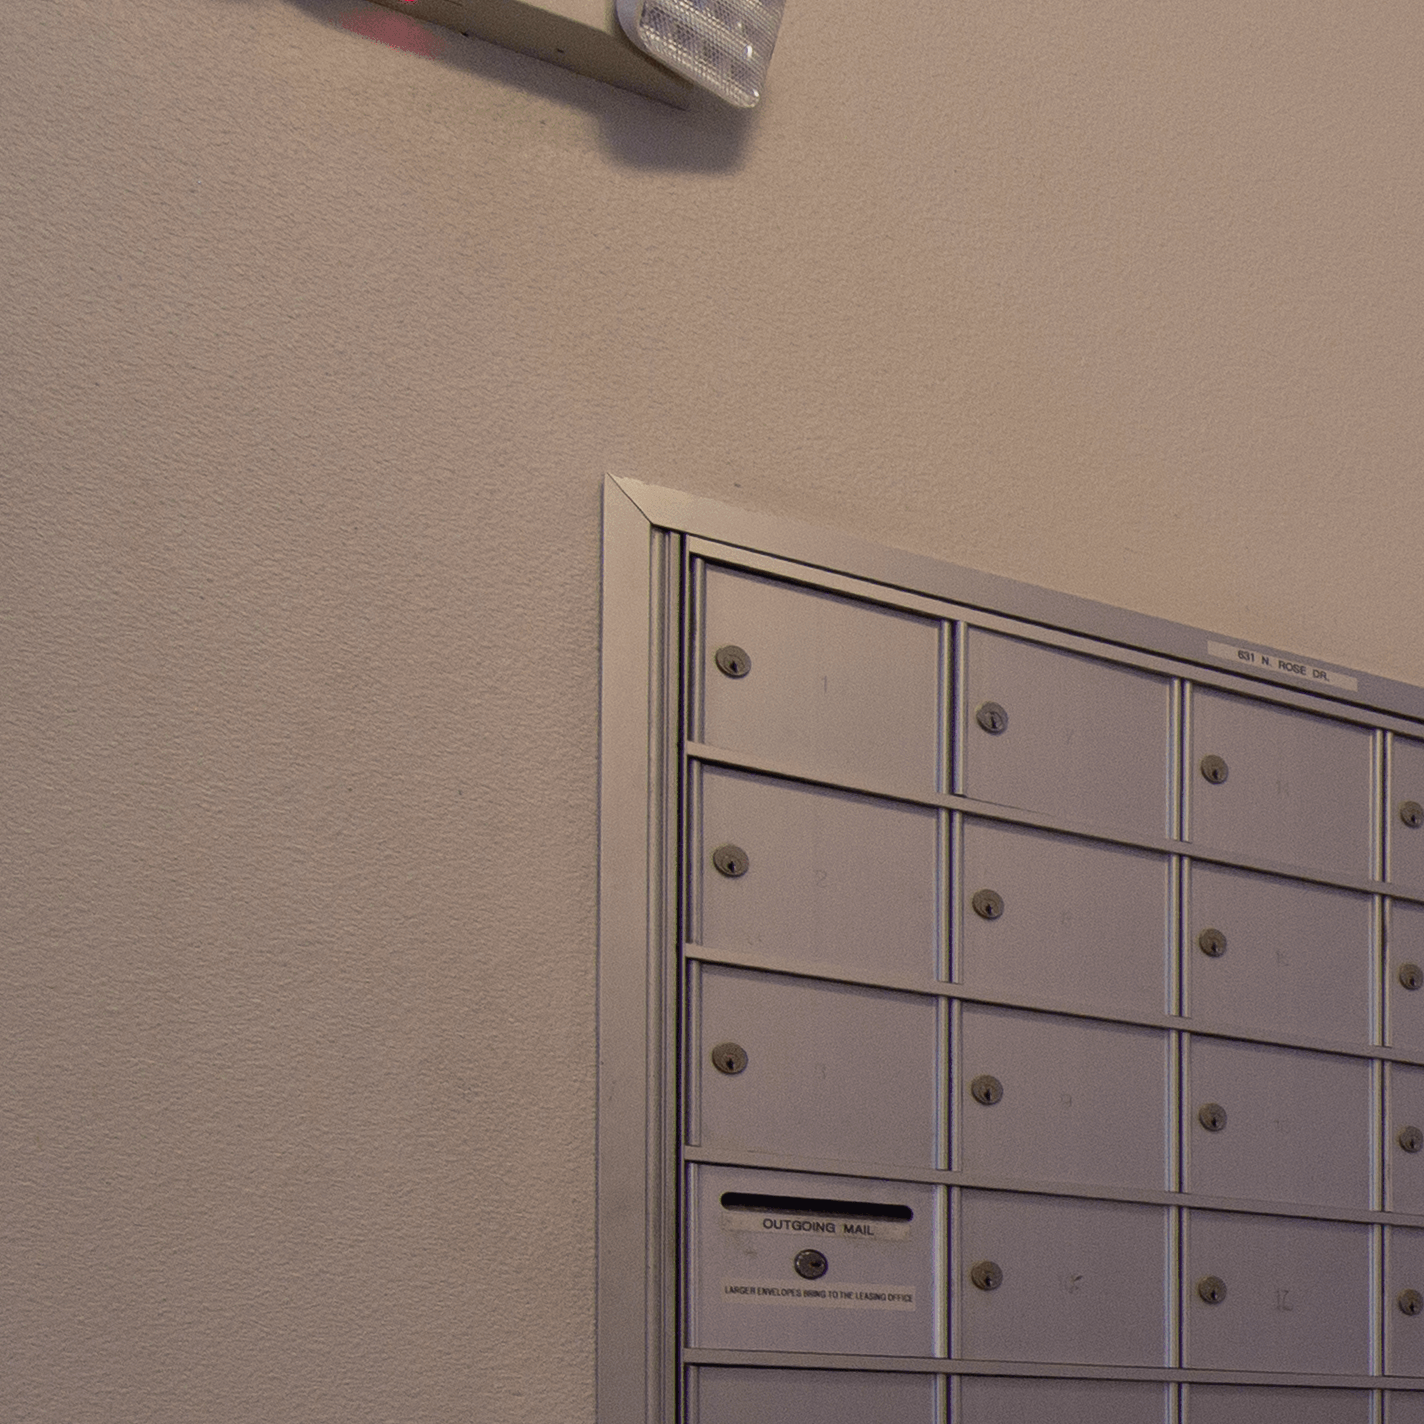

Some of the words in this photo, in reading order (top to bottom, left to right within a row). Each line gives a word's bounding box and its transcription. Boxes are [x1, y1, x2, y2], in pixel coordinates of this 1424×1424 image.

[1237, 650, 1255, 663] 631
[1278, 660, 1307, 675] ROSE
[762, 1218, 836, 1233] OUTGOING
[843, 1224, 875, 1236] MAIL
[724, 1286, 756, 1295] LARGER
[757, 1287, 802, 1297] ENVELOPES
